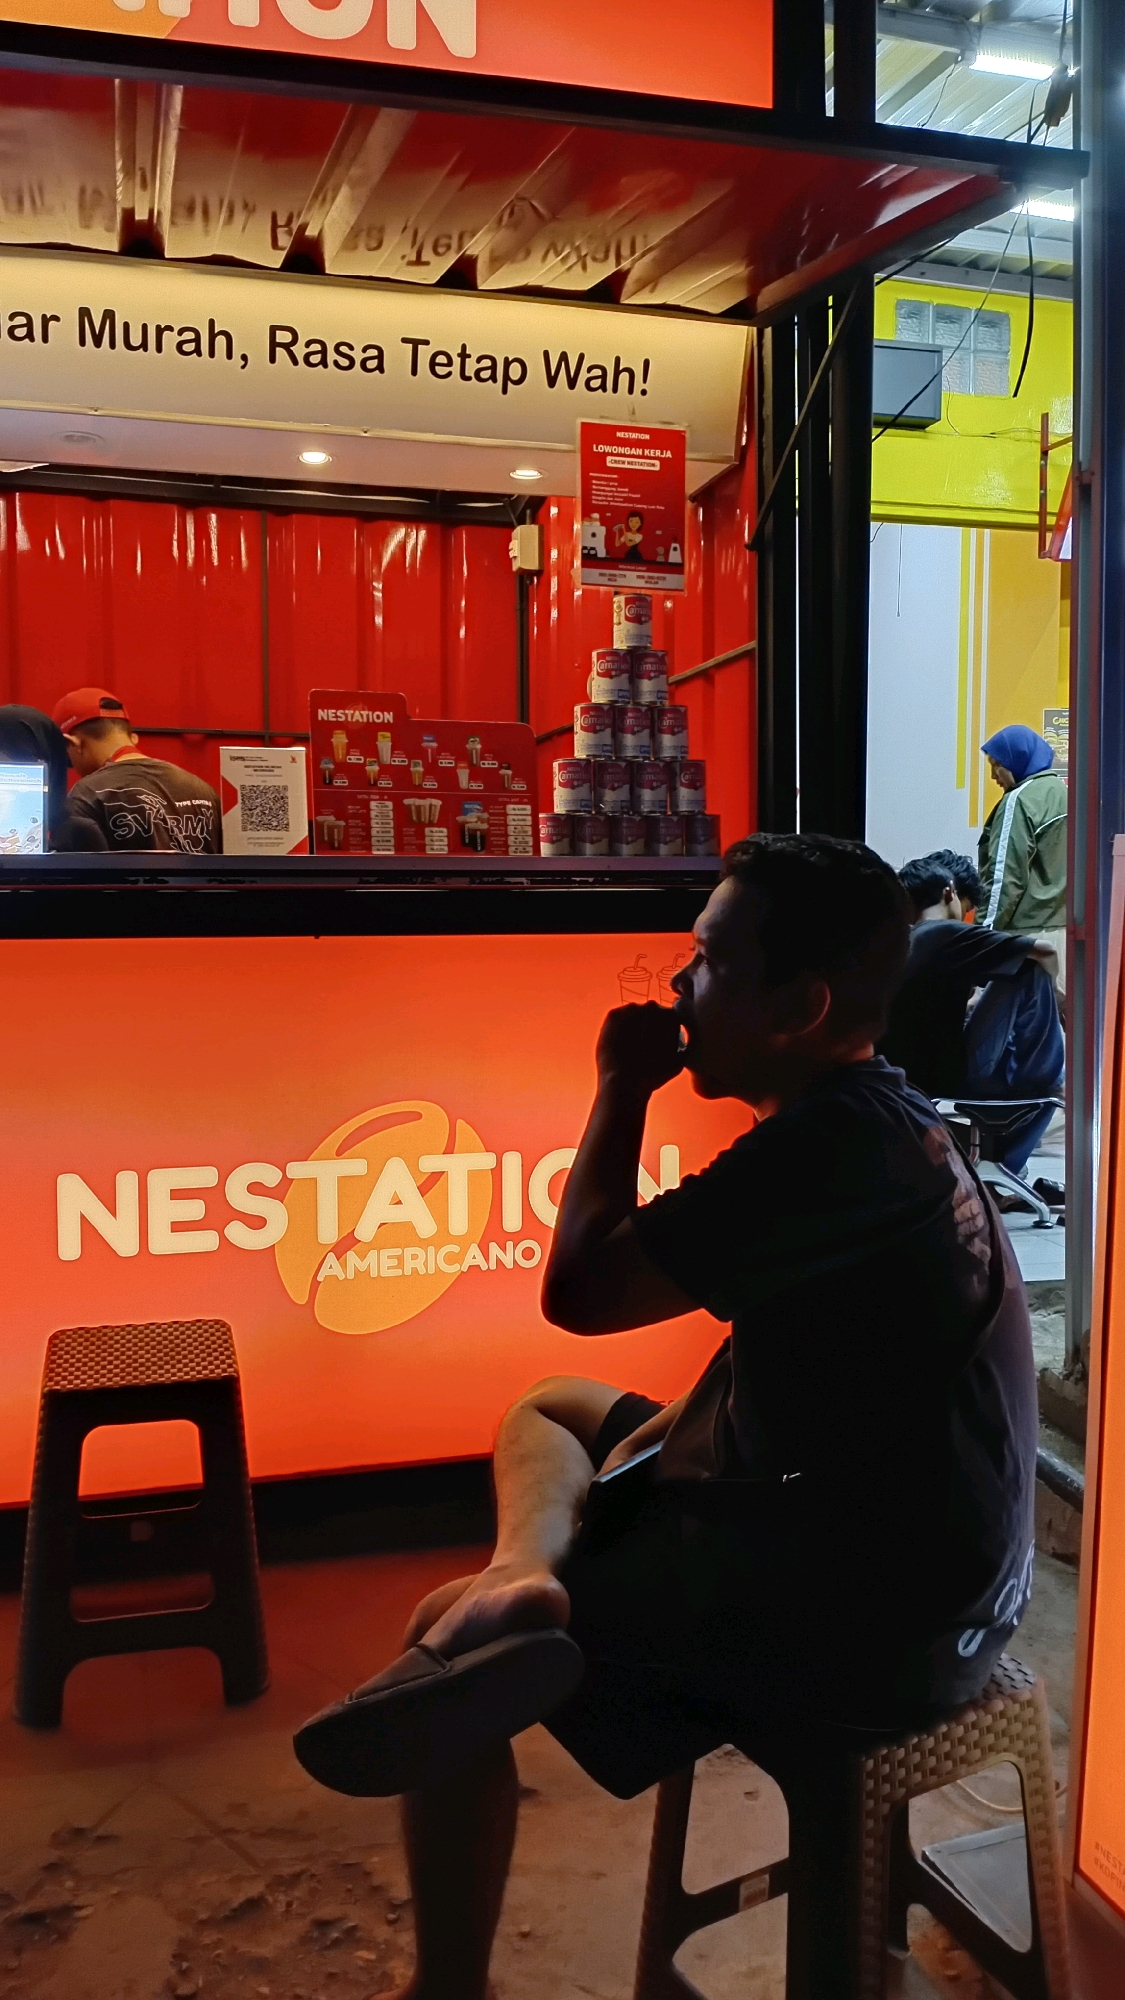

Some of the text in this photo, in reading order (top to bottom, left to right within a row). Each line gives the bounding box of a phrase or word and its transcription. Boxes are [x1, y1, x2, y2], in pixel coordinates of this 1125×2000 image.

[0, 306, 651, 397] ar Murah, Rasa Tetap Wah!
[616, 431, 650, 440] NESTATION
[593, 444, 672, 458] LOWONGAN KERJA
[317, 708, 394, 724] NESTATION
[174, 800, 191, 808] TYPE
[316, 1239, 542, 1281] AMERICANO
